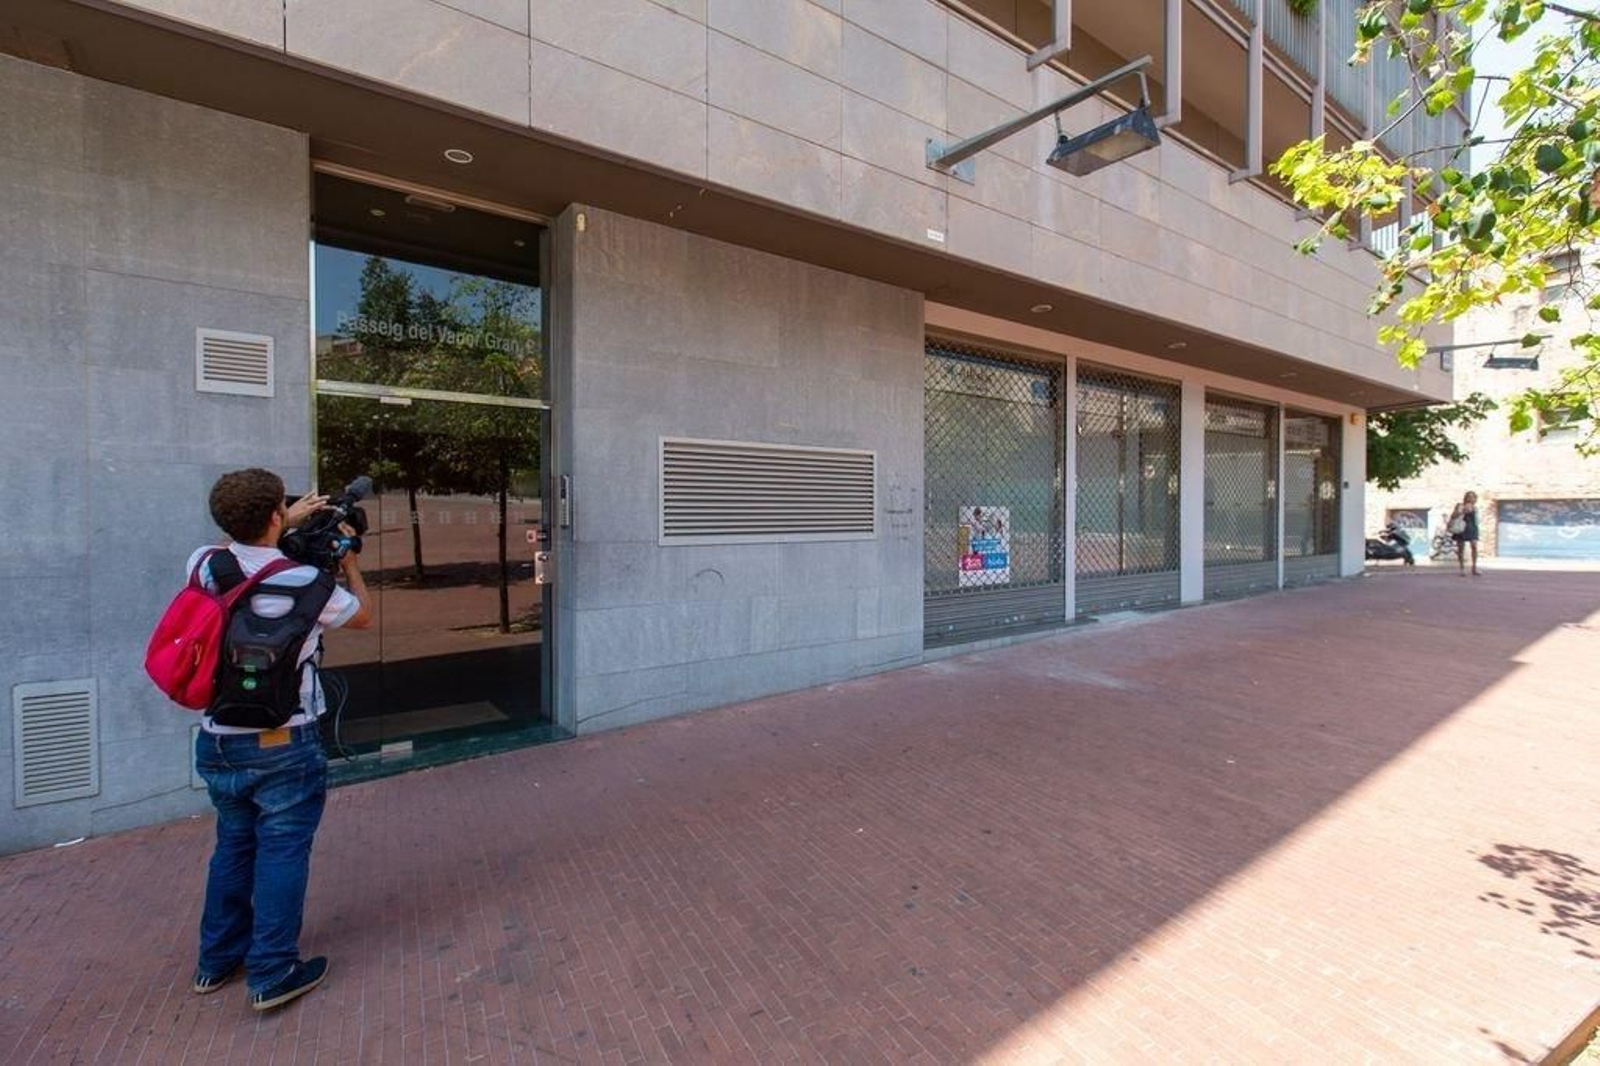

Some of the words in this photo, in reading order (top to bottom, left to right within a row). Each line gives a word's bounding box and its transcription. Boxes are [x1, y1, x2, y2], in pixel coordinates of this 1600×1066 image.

[336, 310, 404, 342] Passeig
[408, 321, 433, 341] del
[437, 325, 480, 350] Vapor
